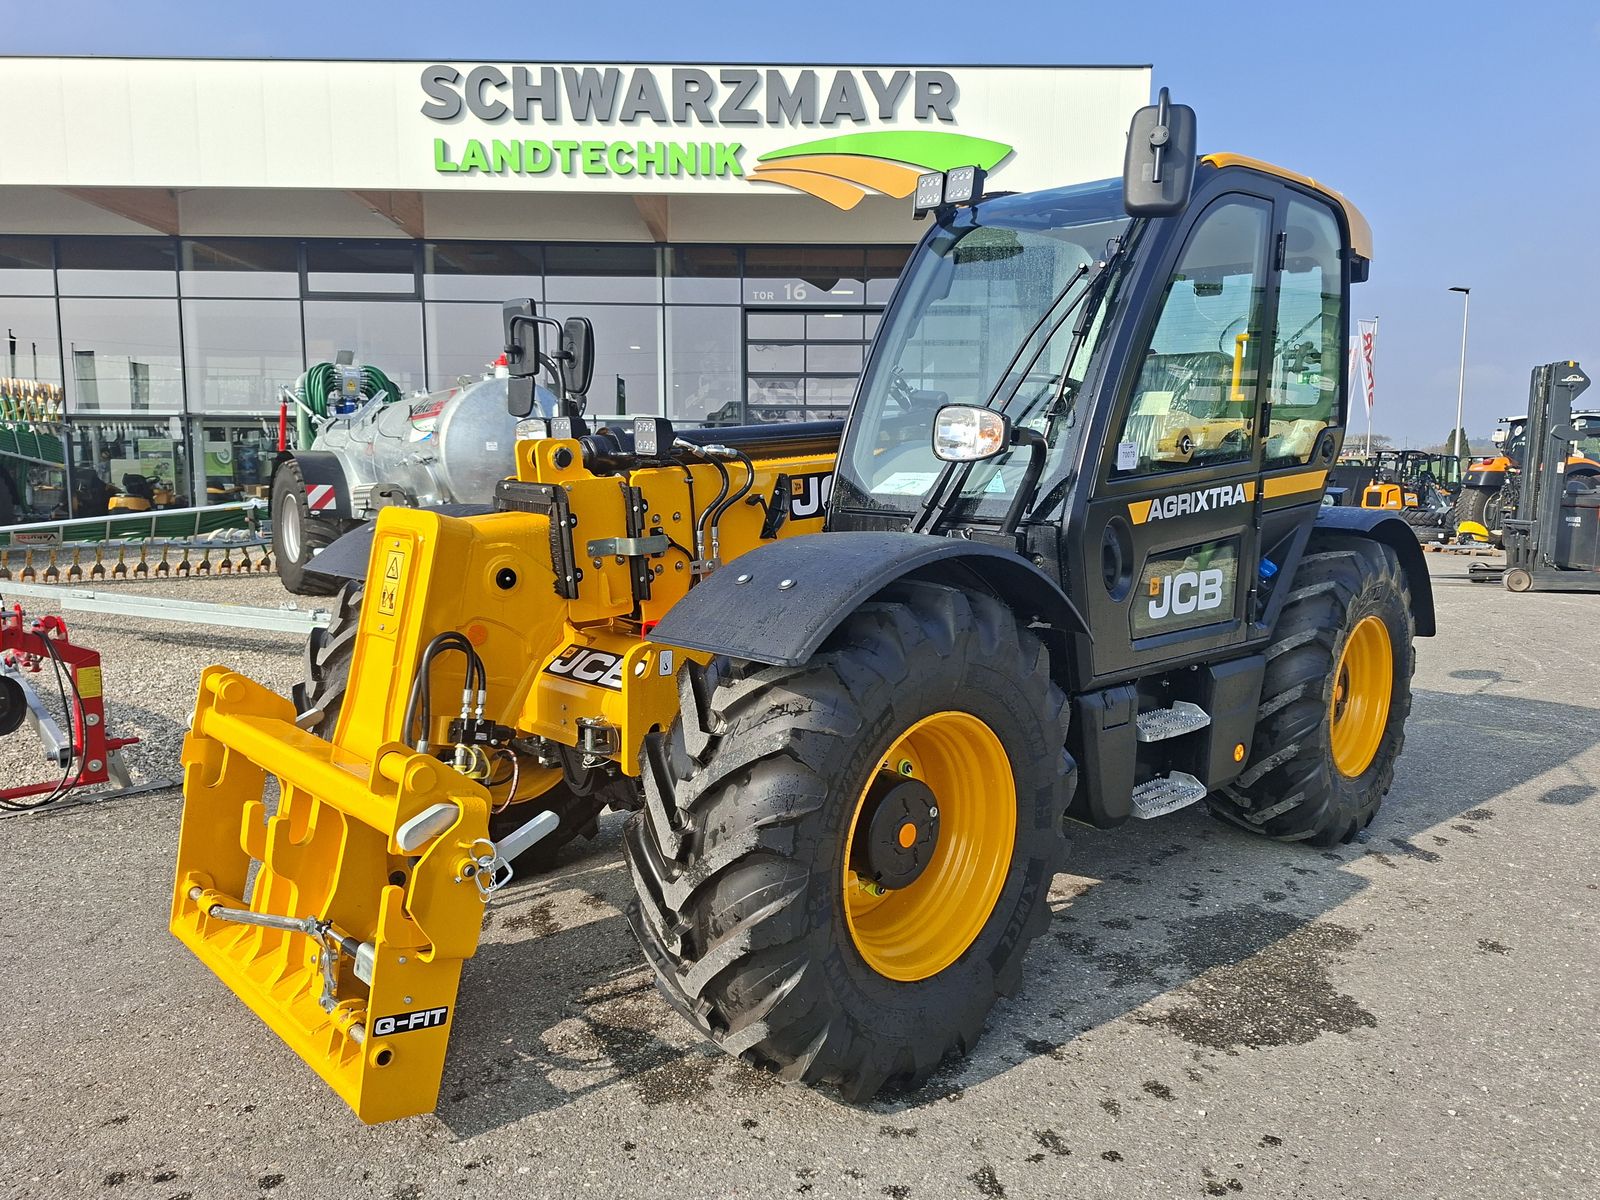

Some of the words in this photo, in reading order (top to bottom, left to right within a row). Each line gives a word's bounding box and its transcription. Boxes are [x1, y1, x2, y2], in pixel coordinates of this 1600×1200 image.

[421, 64, 955, 124] SCHWARZMAYR
[433, 138, 744, 175] LANDTECHNIK
[752, 291, 775, 300] TOR
[783, 283, 807, 300] 16
[1147, 483, 1246, 522] AGRIXTRA
[1148, 568, 1223, 620] JCB
[375, 1008, 447, 1035] Q-FIT
